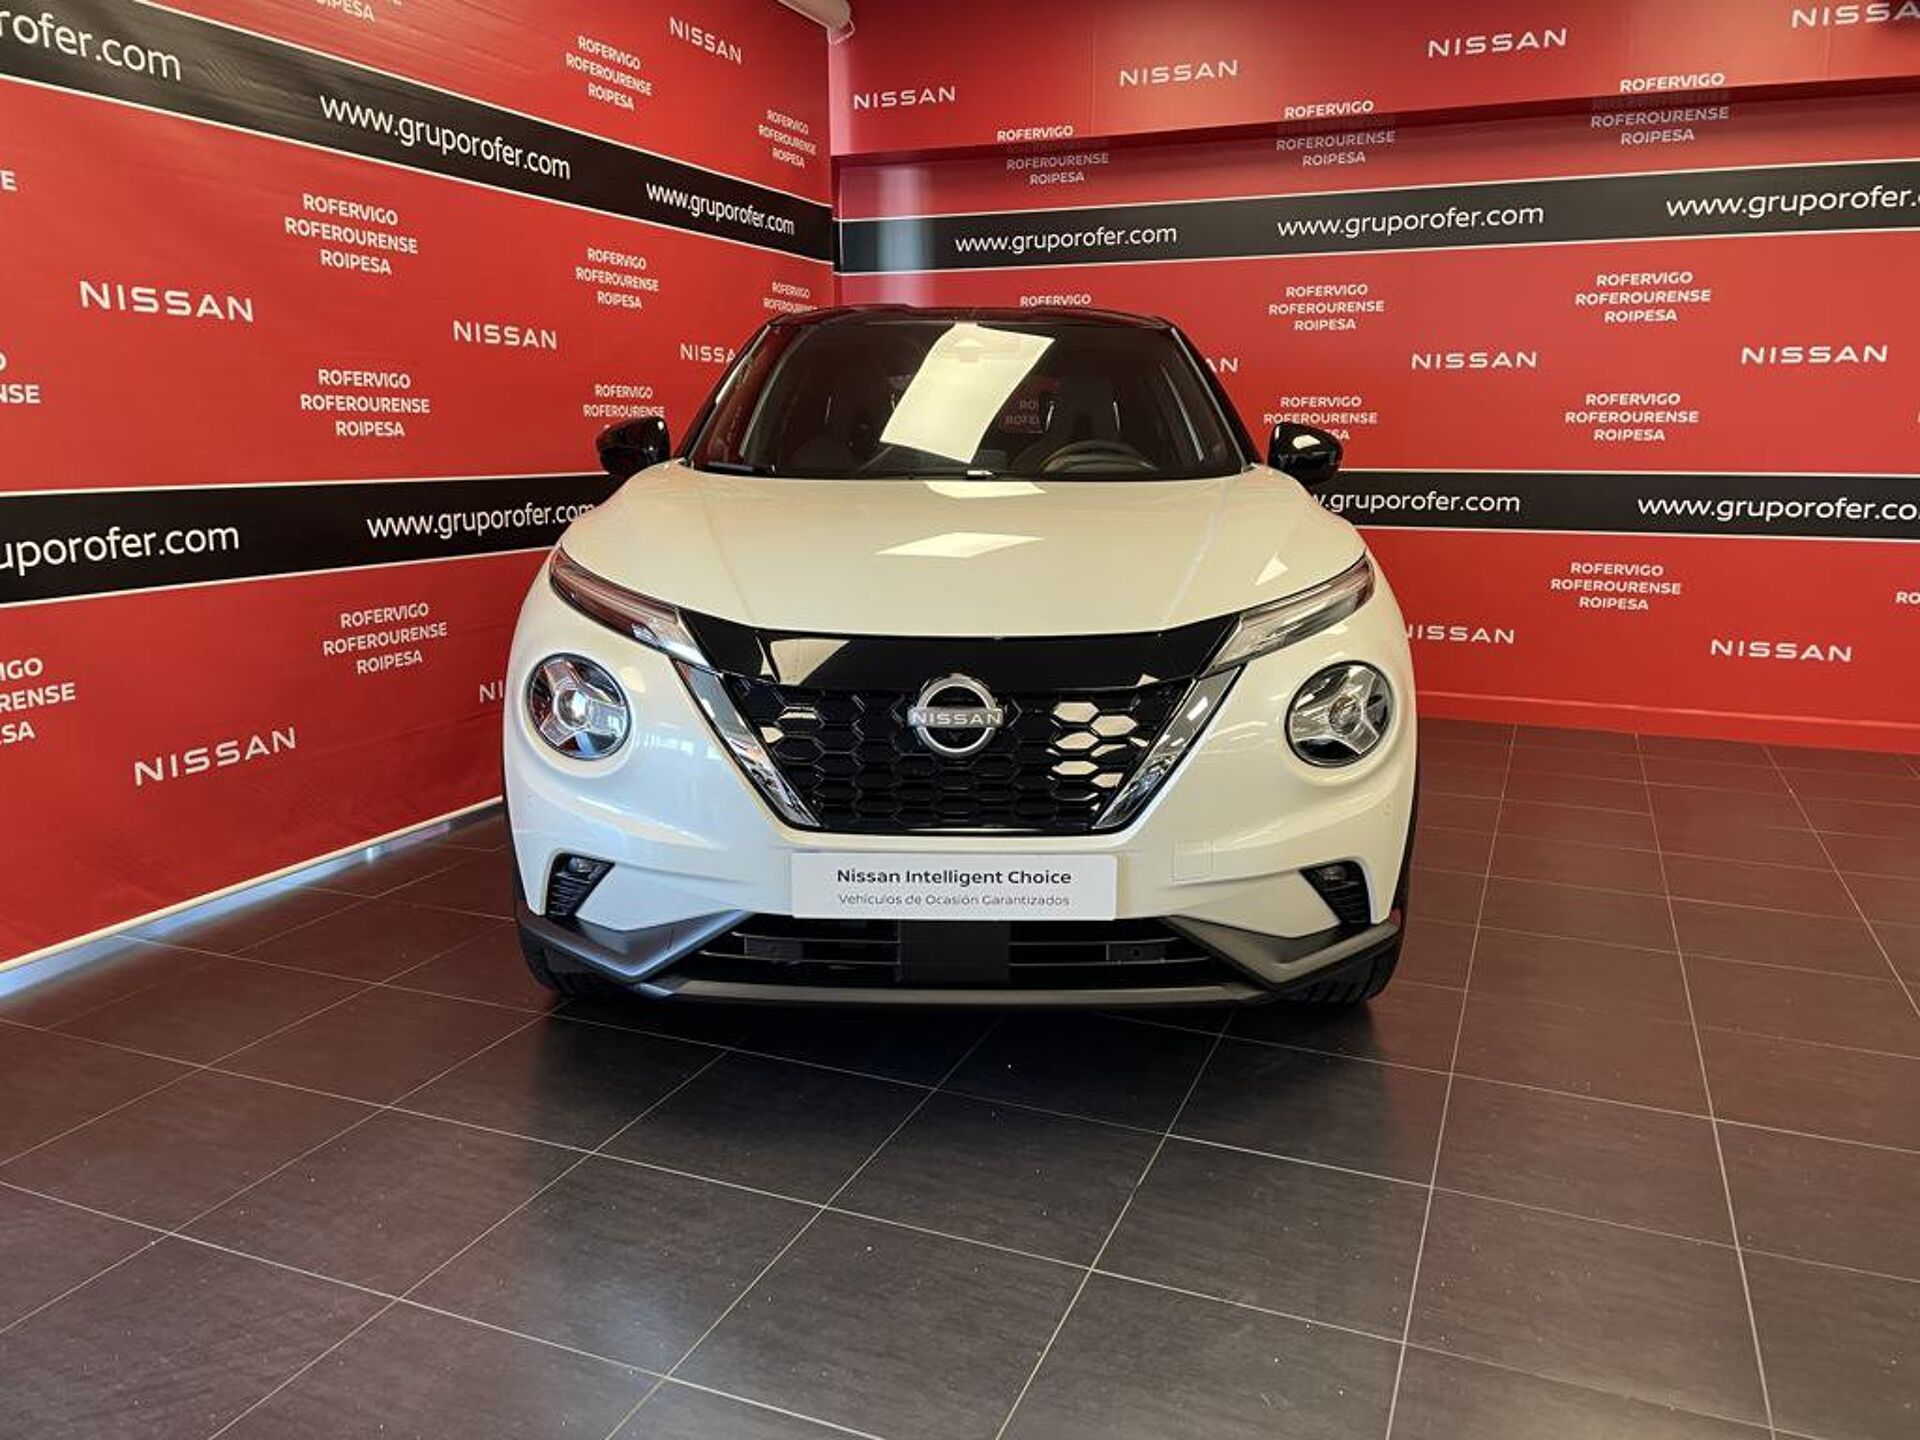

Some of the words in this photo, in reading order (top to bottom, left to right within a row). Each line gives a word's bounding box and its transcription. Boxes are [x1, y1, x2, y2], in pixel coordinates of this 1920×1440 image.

[669, 16, 742, 65] NISSAN
[1428, 27, 1567, 58] NISSAN
[577, 34, 641, 71] ROFERVIGO
[565, 51, 652, 97] ROFEROURENSE
[1119, 59, 1238, 87] NISSAN
[1619, 72, 1726, 93] ROFERVIGO
[587, 81, 635, 111] ROIPESA
[852, 85, 956, 110] NISSAN
[1283, 100, 1375, 120] ROFERVIGO
[1590, 106, 1730, 129] ROFEROURENSE
[319, 95, 571, 180] www.gruporofer.com
[996, 125, 1074, 142] ROFERVIGO
[1275, 130, 1396, 152] ROFEROURENSE
[1620, 128, 1696, 146] ROIPESA
[772, 147, 806, 169] ROIPESA
[1006, 152, 1110, 171] ROFEROURENSE
[1302, 151, 1366, 167] ROIPESA
[1029, 170, 1085, 186] ROIPESA
[302, 192, 399, 226] ROFERVIGO
[645, 182, 795, 236] www.gruporofer.com
[1666, 184, 1920, 219] www.gruporofer.
[1276, 206, 1544, 239] www.gruporofer.com
[284, 216, 419, 255] ROFEROURENSE
[955, 226, 1177, 255] www.gruporofer.com
[319, 248, 393, 275] ROIPESA
[586, 247, 648, 271] ROFERVIGO
[575, 266, 660, 292] ROFEROURENSE
[1596, 271, 1694, 287] ROFERVIGO
[596, 290, 643, 310] ROIPESA
[1285, 283, 1369, 298] ROFERVIGO
[1574, 289, 1711, 306] ROFEROURENSE
[79, 280, 254, 323] NISSAN
[1268, 299, 1385, 316] ROFEROURENSE
[1293, 317, 1357, 332] ROIPESA
[1604, 308, 1678, 324] ROIPESA
[453, 320, 557, 350] NISSAN
[1411, 351, 1537, 370] NISSAN
[1741, 344, 1888, 365] NISSAN
[318, 368, 412, 390] ROFERVIGO
[594, 383, 654, 400] ROFERVIGO
[1280, 395, 1363, 408] ROFERVIGO
[1585, 392, 1681, 406] ROFERVIGO
[299, 393, 431, 414] ROFEROURENSE
[1263, 411, 1378, 426] ROFEROURENSE
[1564, 410, 1699, 424] ROFEROURENSE
[335, 420, 406, 438] ROIPESA
[1593, 428, 1666, 442] ROIPESA
[1637, 496, 1920, 523] www.gruporofer.co
[1570, 561, 1664, 577] ROFERVIGO
[1550, 578, 1682, 596] ROFEROURENSE
[1578, 595, 1649, 611] ROIPESA
[340, 602, 430, 629] ROFERVIGO
[322, 621, 448, 657] ROFEROURENSE
[1710, 639, 1852, 663] NISSAN
[356, 649, 423, 675] ROIPESA
[911, 712, 1001, 726] NISSAN
[134, 727, 296, 786] NISSAN
[837, 869, 900, 884] Nissan
[905, 870, 1003, 887] Intelligent
[1008, 870, 1071, 885] Choice
[839, 893, 902, 906] Vehículos
[905, 893, 922, 906] de
[926, 893, 979, 906] Ocasión
[982, 895, 1070, 907] Garantizados
